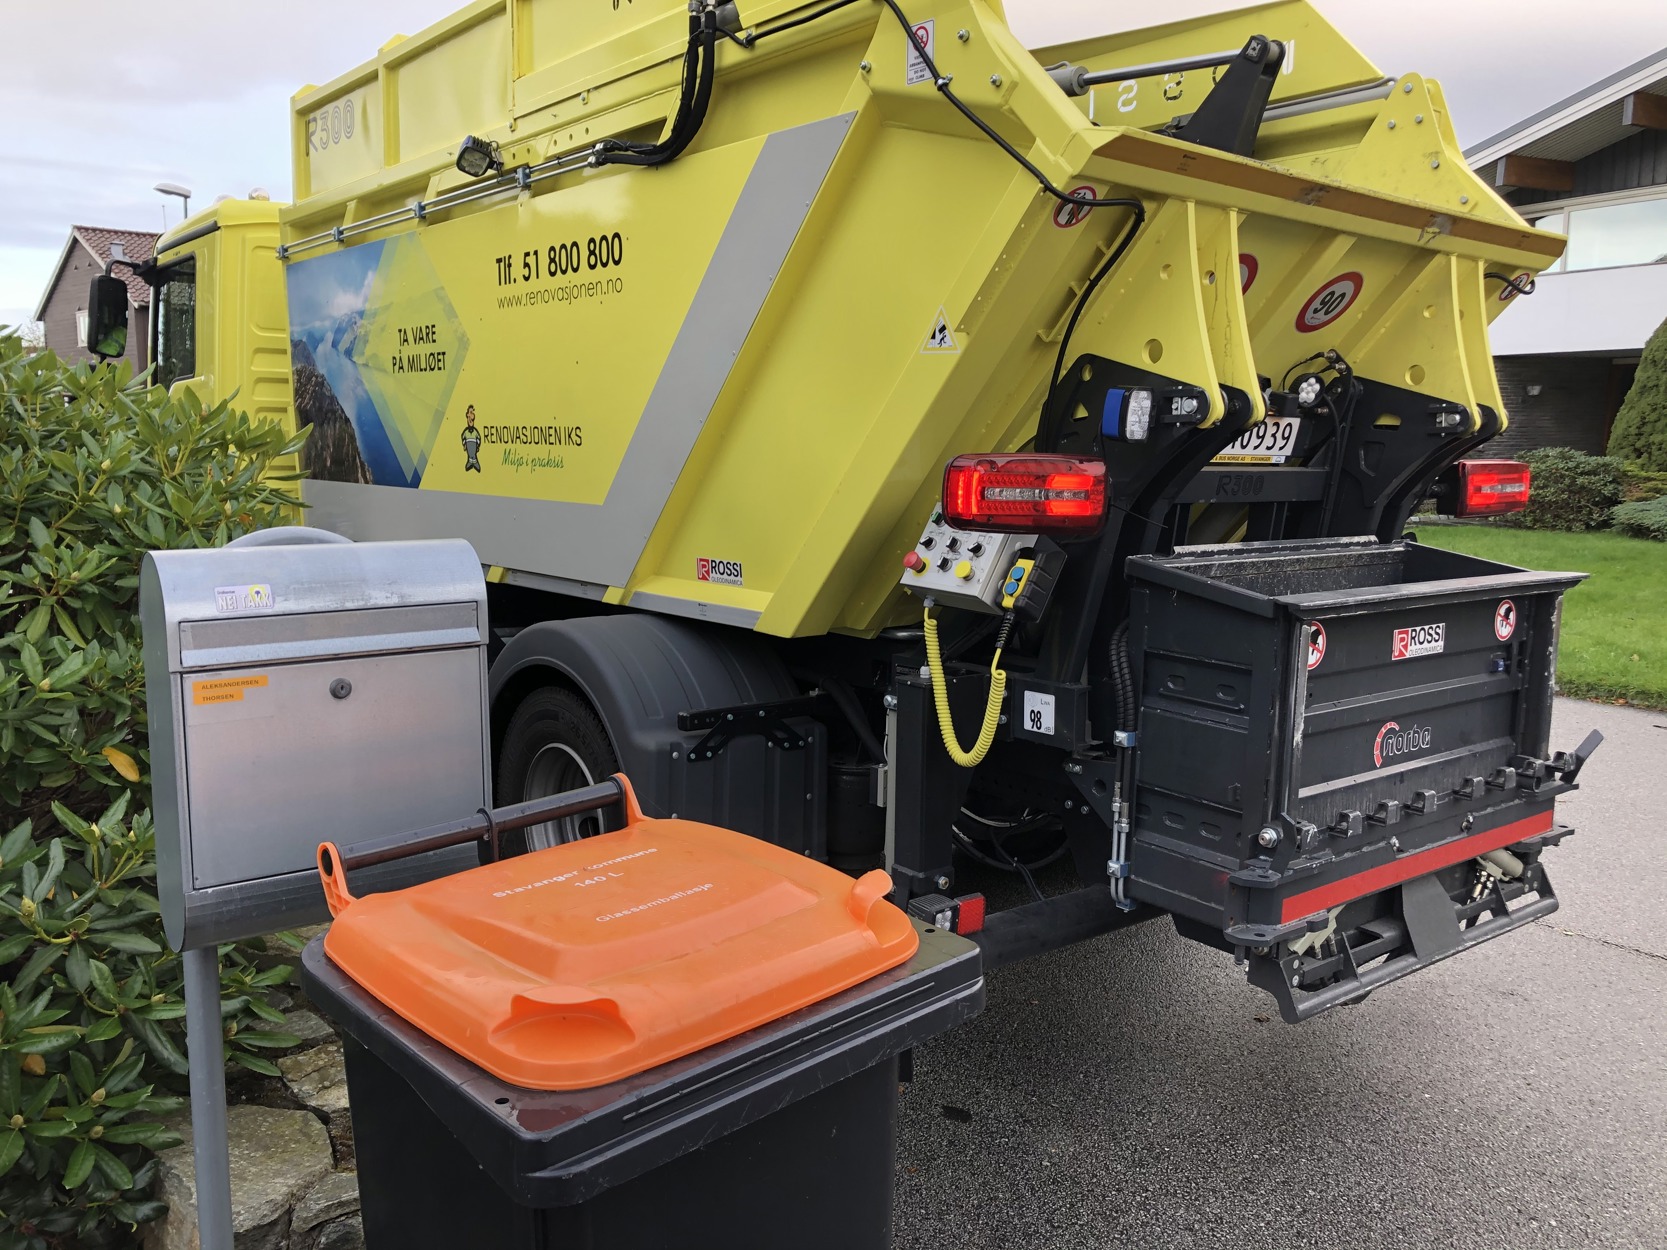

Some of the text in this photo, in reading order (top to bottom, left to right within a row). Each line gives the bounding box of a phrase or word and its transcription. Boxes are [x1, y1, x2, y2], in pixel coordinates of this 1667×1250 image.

[305, 99, 354, 157] R300
[495, 232, 622, 286] Tlf. 51 800 800
[497, 277, 623, 309] www.renovasjonen.no
[1313, 290, 1346, 316] 90
[398, 324, 437, 347] TA VARE
[392, 349, 446, 374] PÅ MILJØET
[483, 425, 582, 447] RENOVASJONEN IKS
[531, 449, 565, 474] praksis
[1216, 475, 1265, 497] R300
[711, 559, 743, 579] ROSSI
[217, 593, 272, 612] NEI TAKK
[1409, 624, 1445, 647] ROSSI
[202, 693, 235, 703] THORSEN
[1030, 709, 1042, 731] 98
[1383, 723, 1432, 757] norba
[492, 869, 579, 898] Stavanger
[574, 874, 607, 888] 140
[595, 882, 714, 923] Glassemballasje
